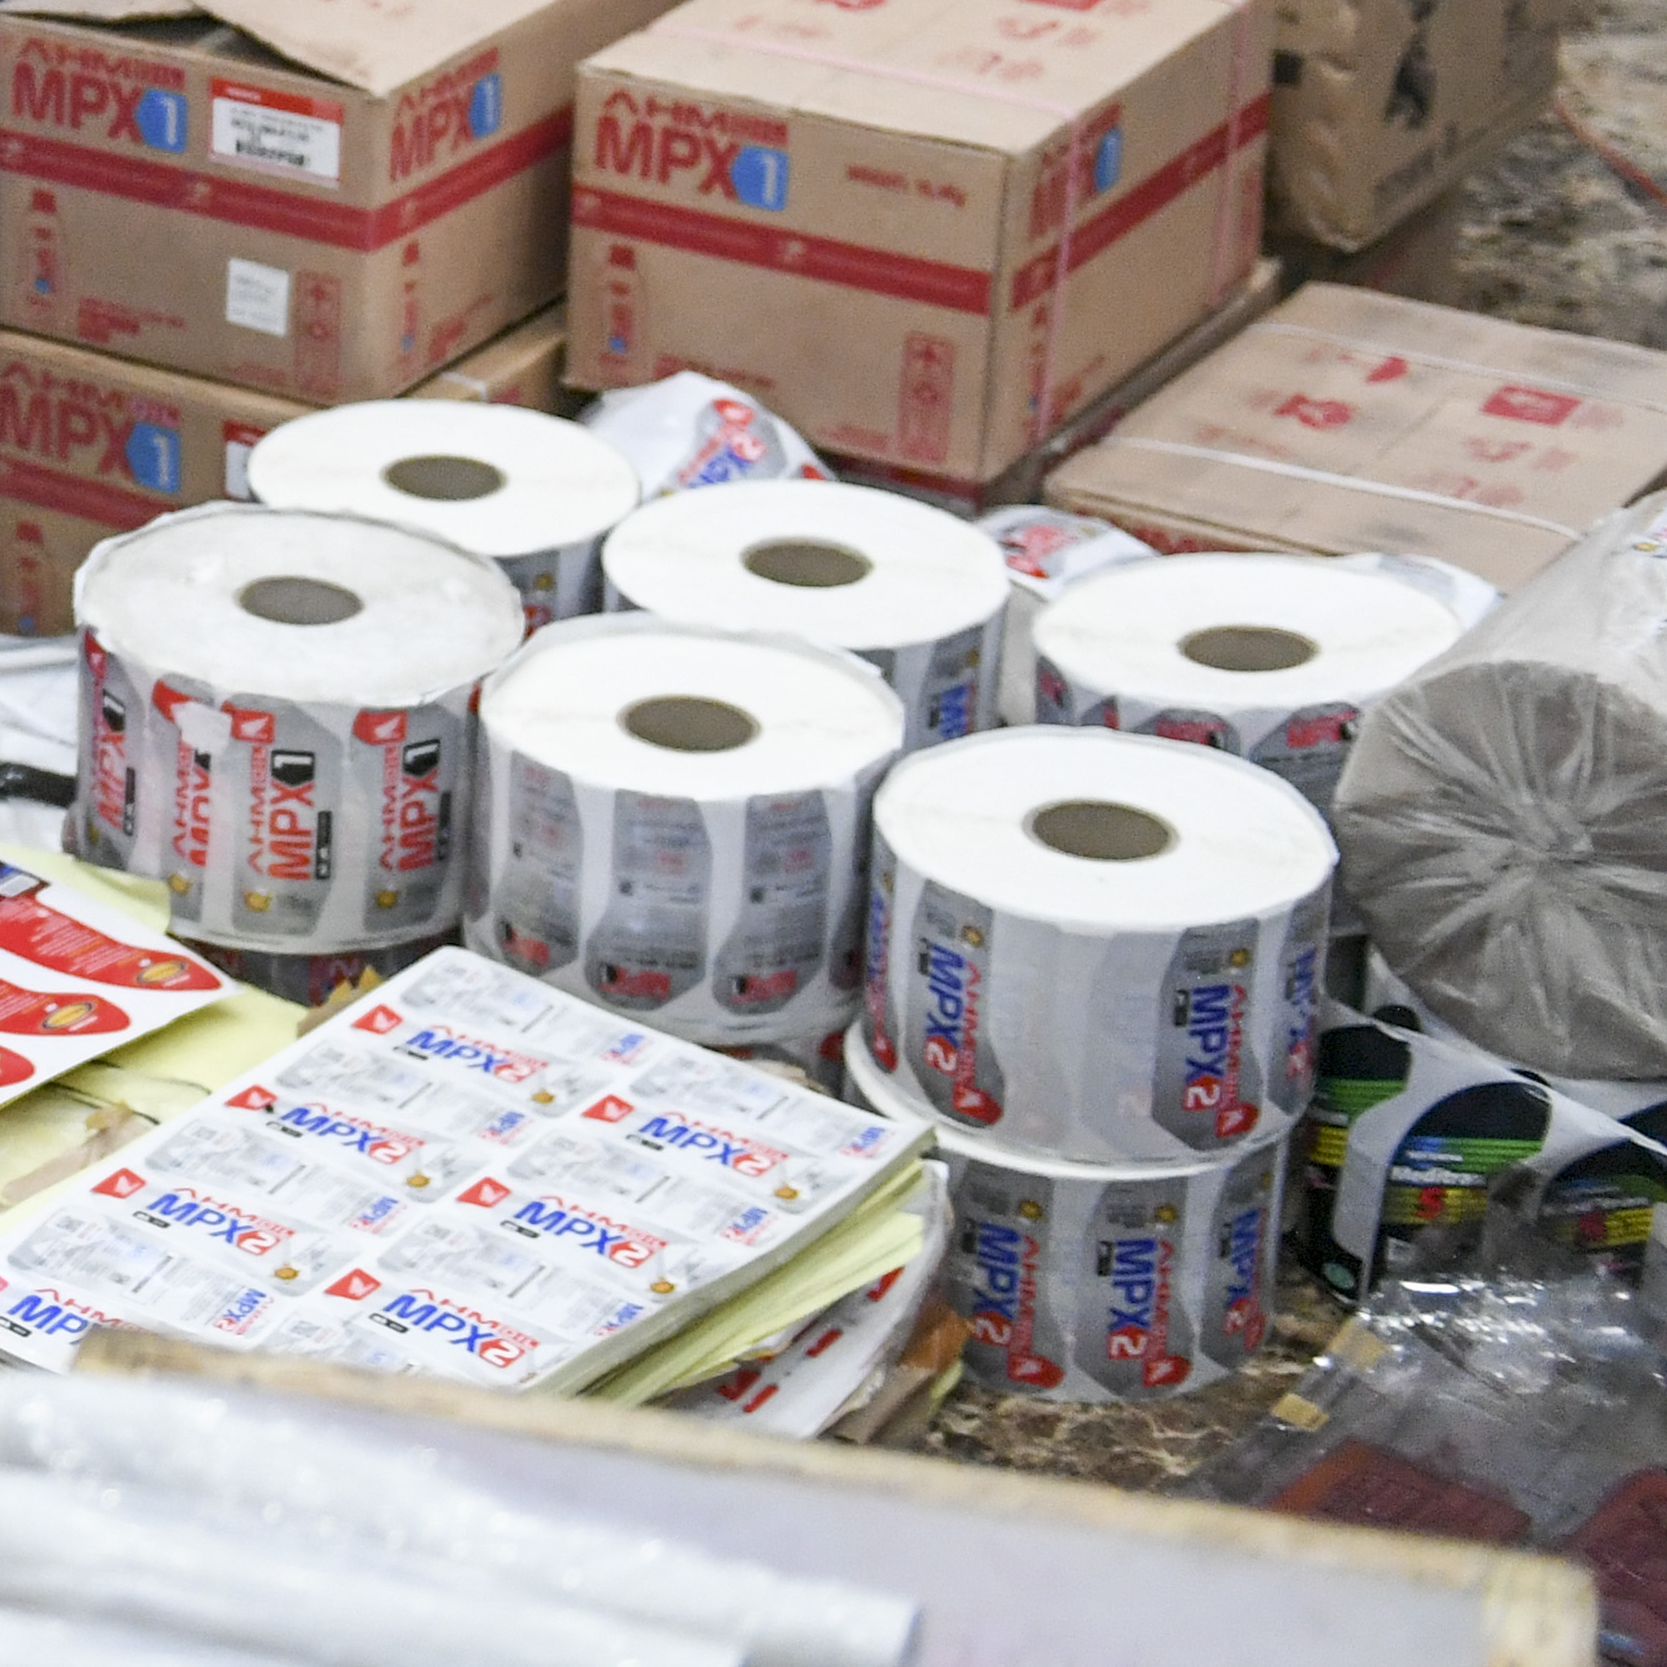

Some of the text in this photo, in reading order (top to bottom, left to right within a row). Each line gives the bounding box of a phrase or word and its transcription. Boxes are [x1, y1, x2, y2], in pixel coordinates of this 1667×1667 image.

[11, 64, 188, 154] MPX1
[389, 73, 501, 183] MPX1
[594, 116, 790, 212] MPX1
[267, 749, 315, 881] MPX1
[398, 739, 441, 873] MPX1
[924, 941, 965, 1072] MPX2
[1183, 984, 1230, 1111] MPX2
[404, 1030, 539, 1084] MPX2
[279, 1108, 414, 1165] MPX2
[636, 1116, 777, 1178] MPX2
[146, 1193, 281, 1256] MPX2
[513, 1201, 655, 1269] MPX2
[7, 1295, 95, 1346] MP
[971, 1222, 1019, 1346] MPX2
[1108, 1239, 1157, 1359] MPX2
[382, 1294, 525, 1369] MPX2
